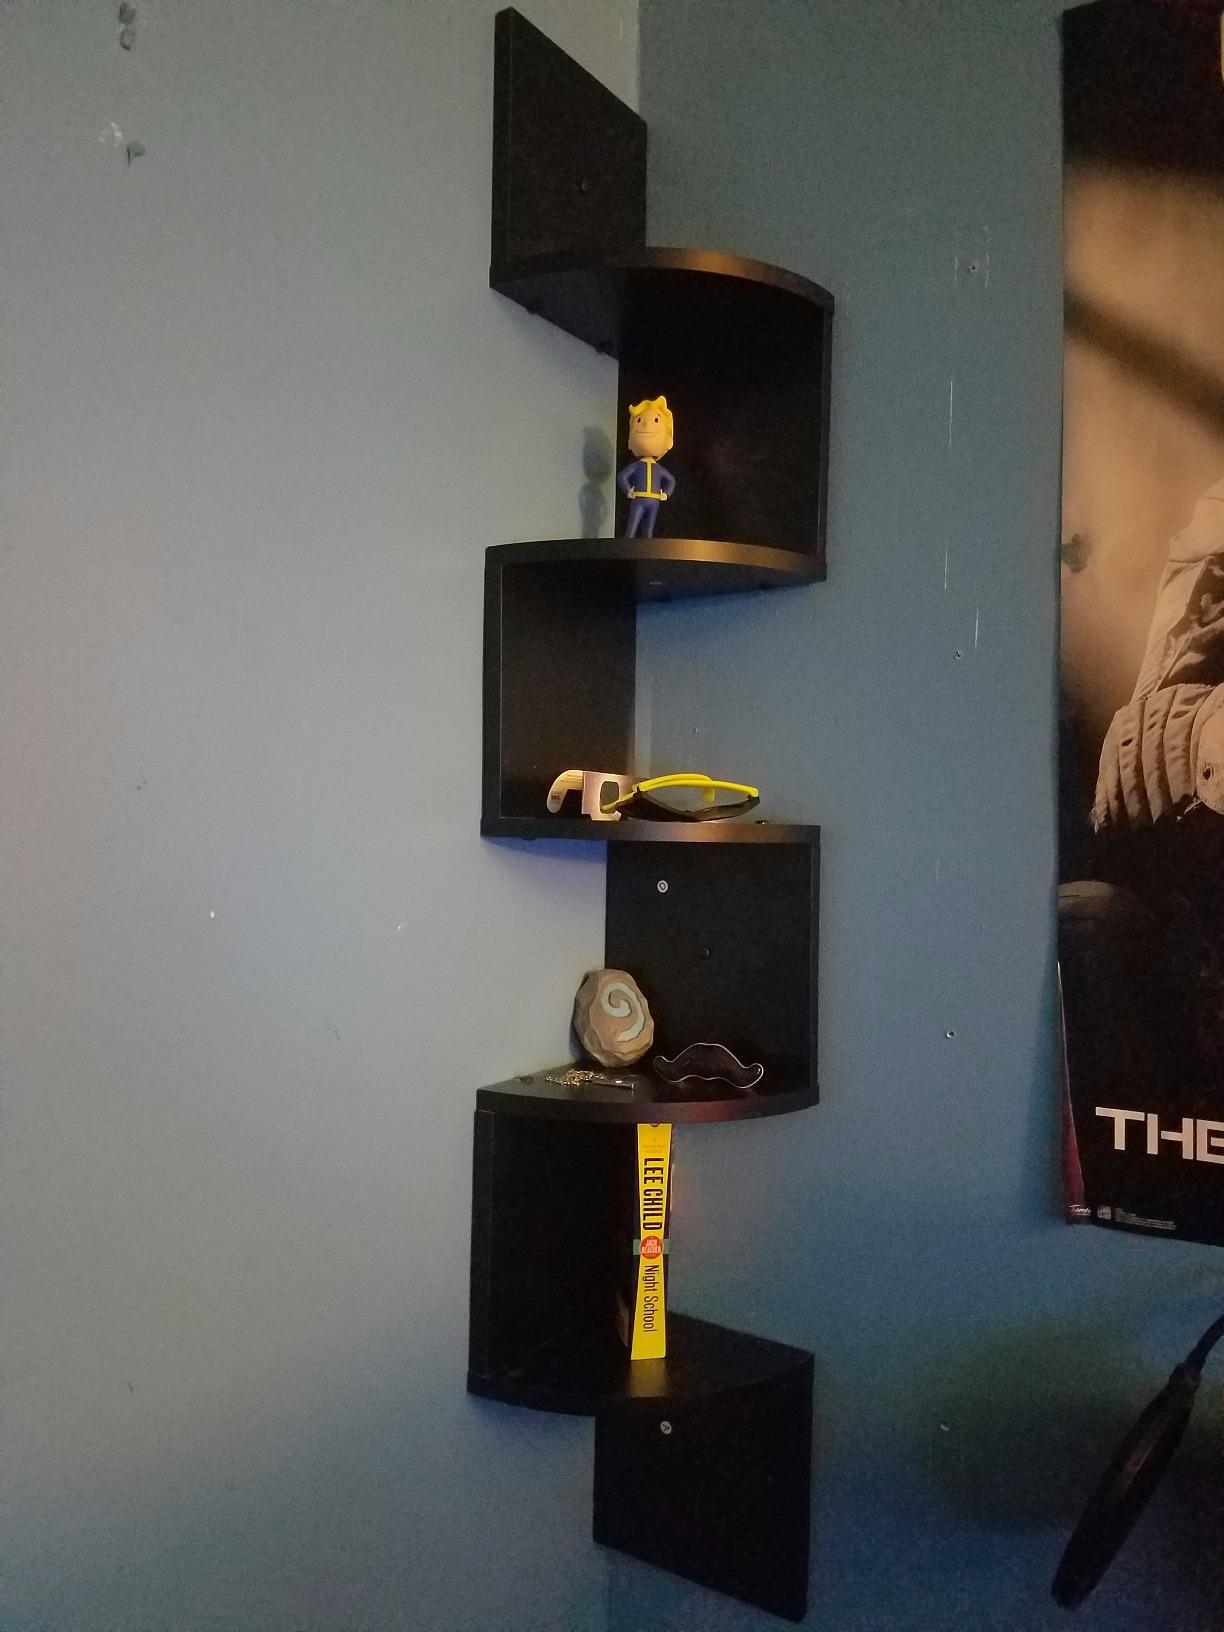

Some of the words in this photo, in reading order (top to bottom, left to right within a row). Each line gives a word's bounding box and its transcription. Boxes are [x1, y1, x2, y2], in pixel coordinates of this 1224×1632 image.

[1095, 1106, 1224, 1165] THE
[643, 1157, 665, 1185] LEE
[642, 1188, 664, 1231] CHILD
[645, 1239, 658, 1247] JACK
[643, 1265, 660, 1293] Night
[642, 1295, 659, 1333] School
